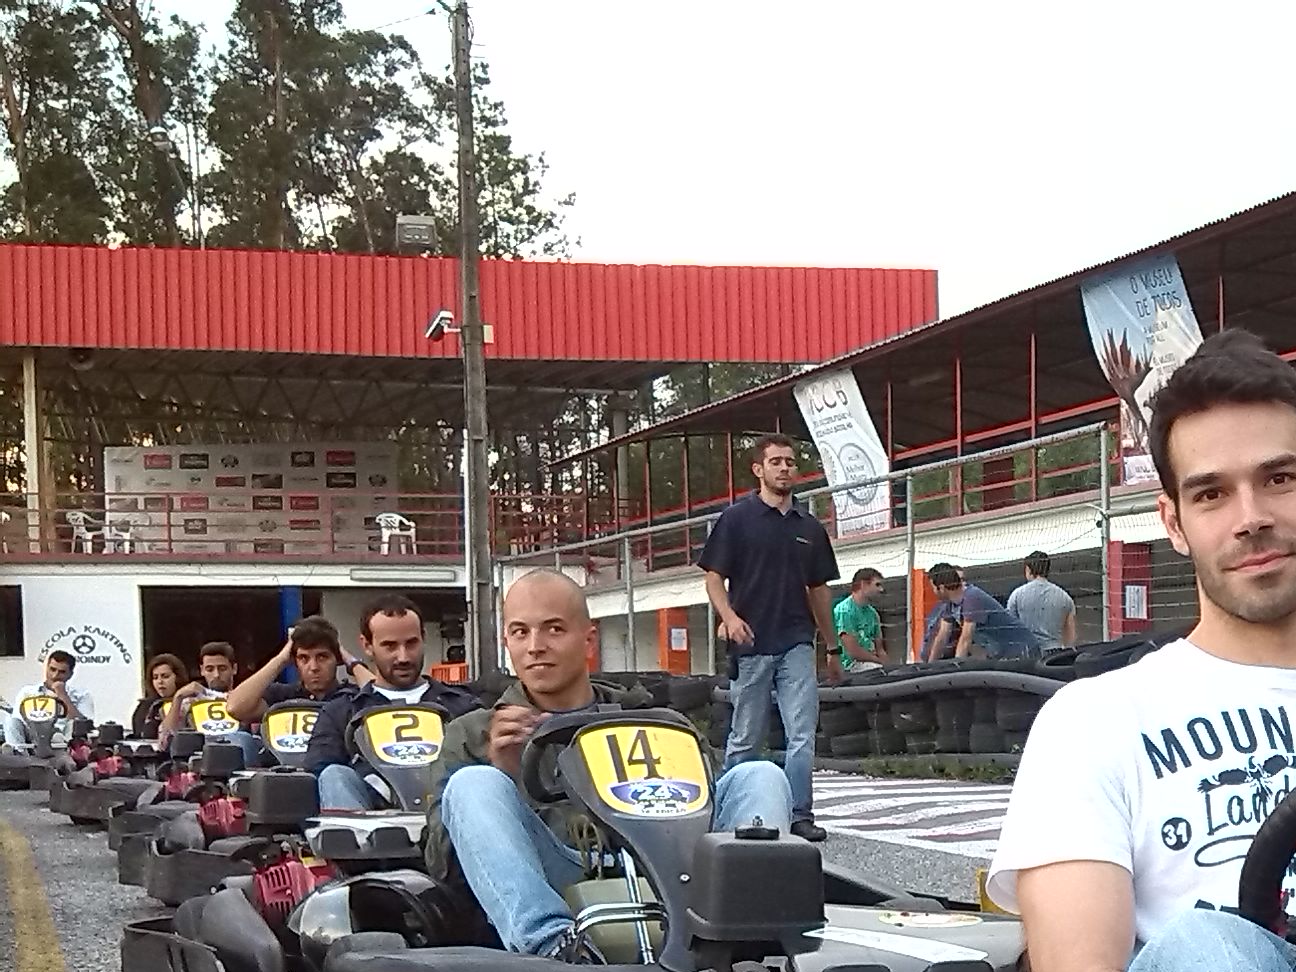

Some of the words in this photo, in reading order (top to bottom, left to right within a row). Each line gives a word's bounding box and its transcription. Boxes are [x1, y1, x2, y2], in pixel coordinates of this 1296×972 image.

[1135, 297, 1151, 318] DE
[38, 626, 76, 663] ESCOLA
[84, 625, 132, 664] KARTING
[31, 699, 49, 711] 17
[207, 703, 226, 721] 6
[291, 713, 319, 735] 18
[391, 713, 423, 743] 2
[605, 729, 665, 783] 14
